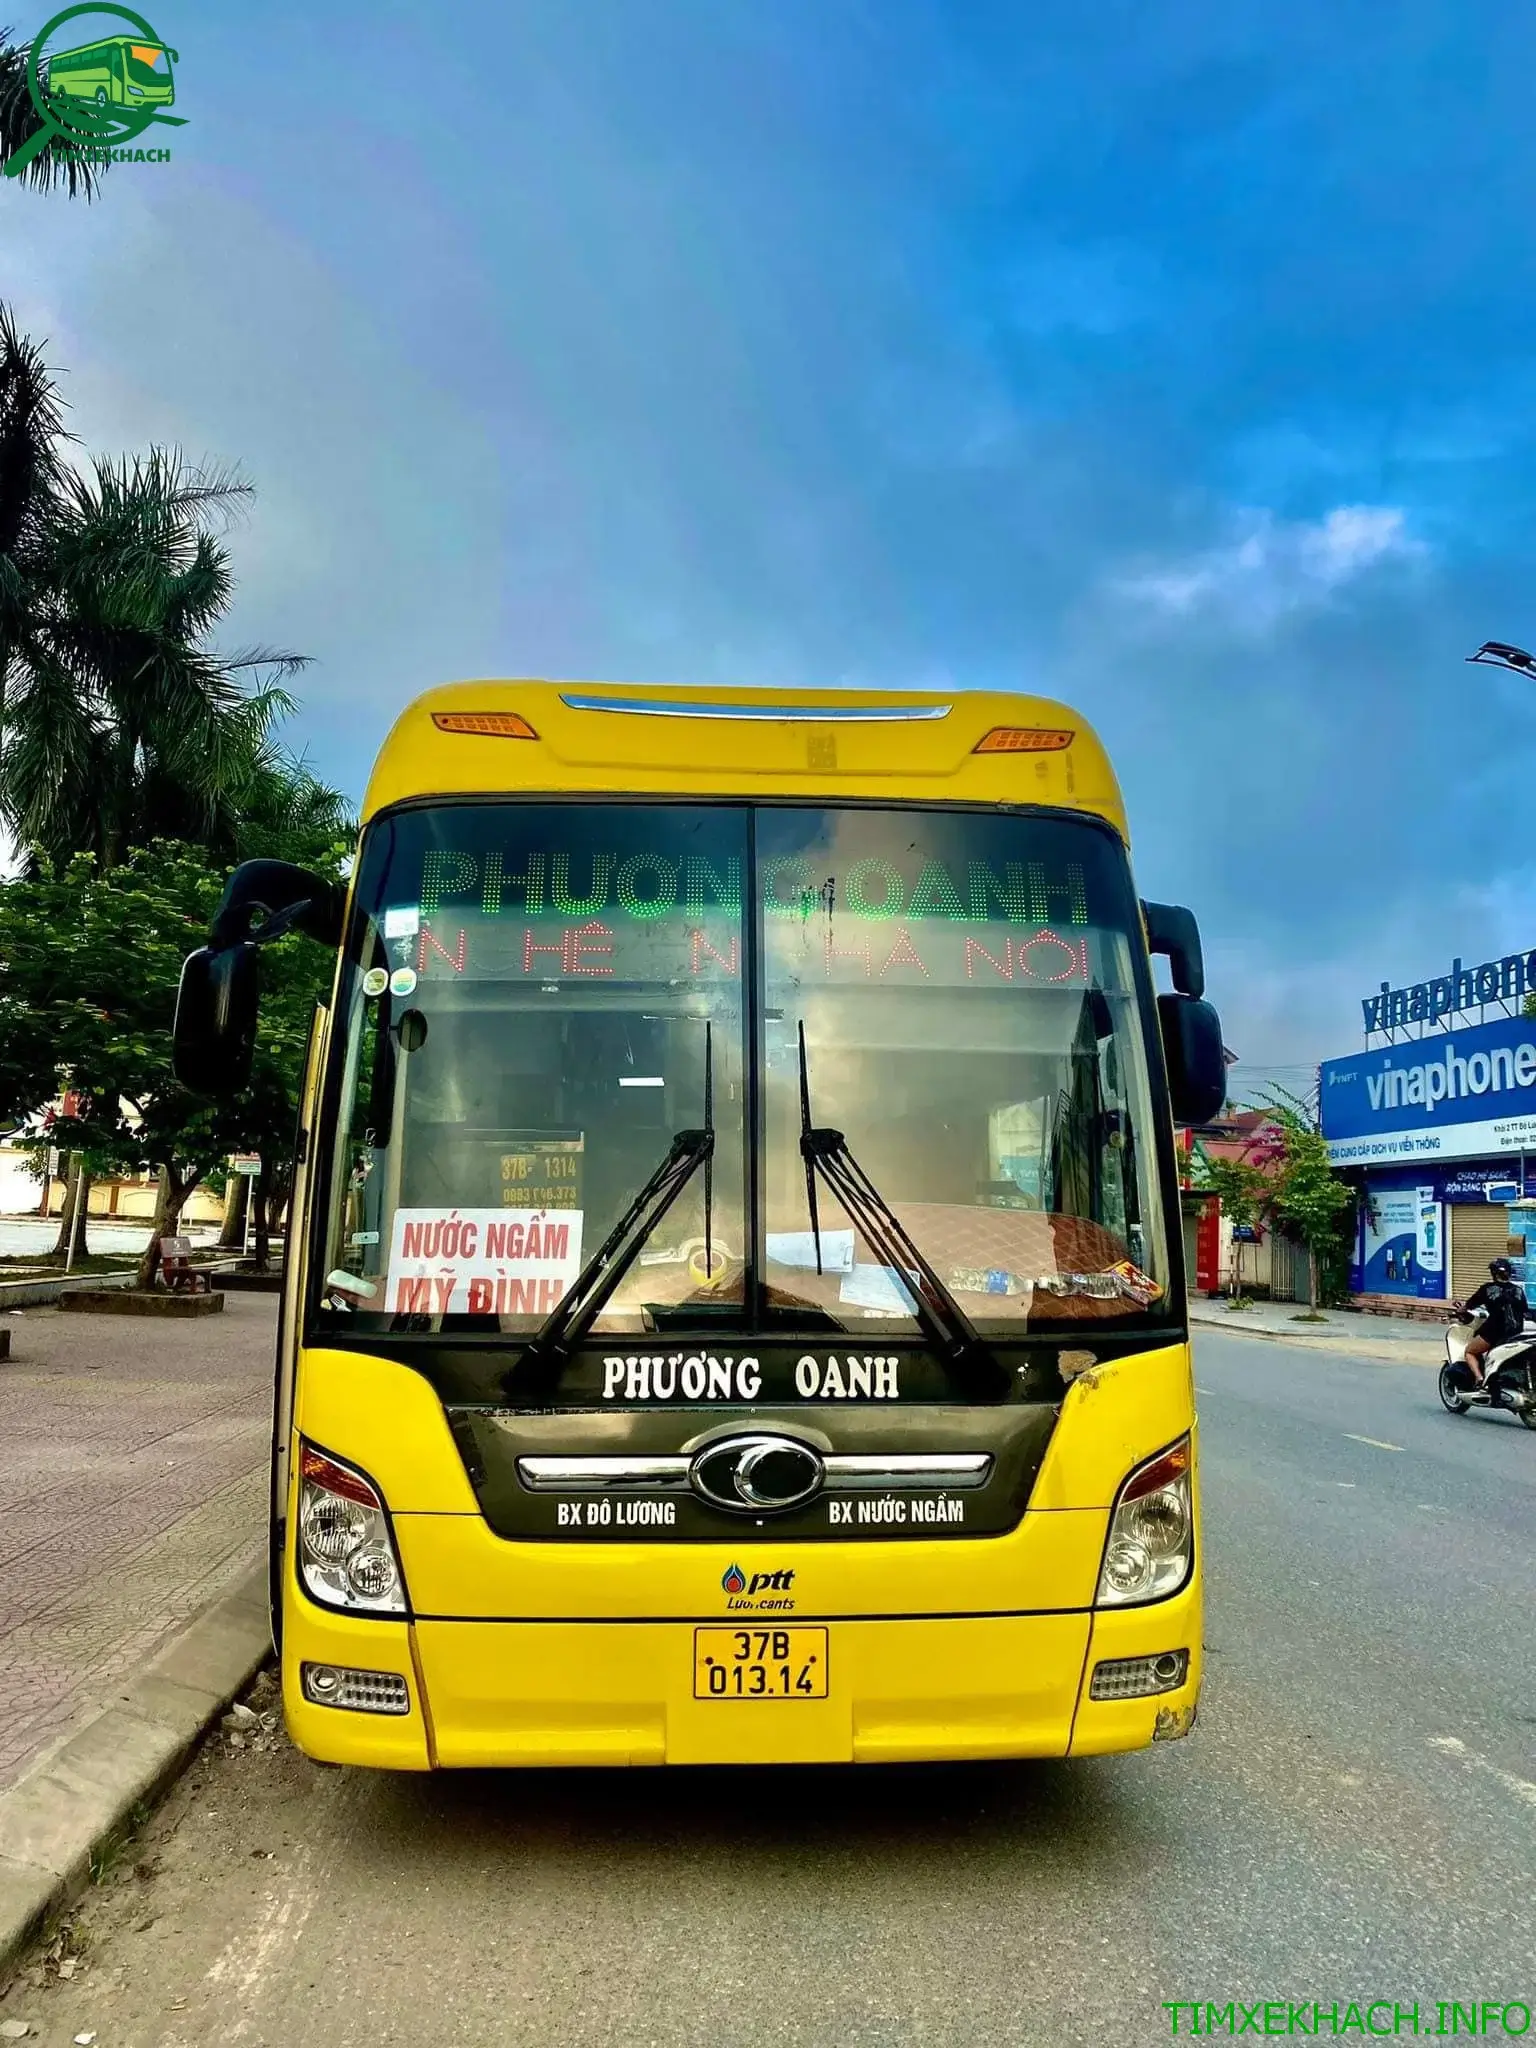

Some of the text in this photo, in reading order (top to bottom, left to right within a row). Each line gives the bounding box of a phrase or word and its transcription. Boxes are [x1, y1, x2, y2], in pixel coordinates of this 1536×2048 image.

[845, 857, 1088, 925] OANH
[1366, 1043, 1536, 1111] vinaphone
[544, 1155, 577, 1179] 1314
[402, 1210, 477, 1259] NƯỚC
[396, 1266, 564, 1314] MỸ ĐÌNH
[602, 1350, 900, 1400] PHƯƠNG OANH
[557, 1498, 676, 1525] BX ĐÔ LƯƠNG
[829, 1492, 964, 1524] BX NƯỚC NGẦM
[747, 1569, 796, 1595] ptt
[733, 1631, 790, 1661] 37B
[708, 1664, 813, 1695] 013.14
